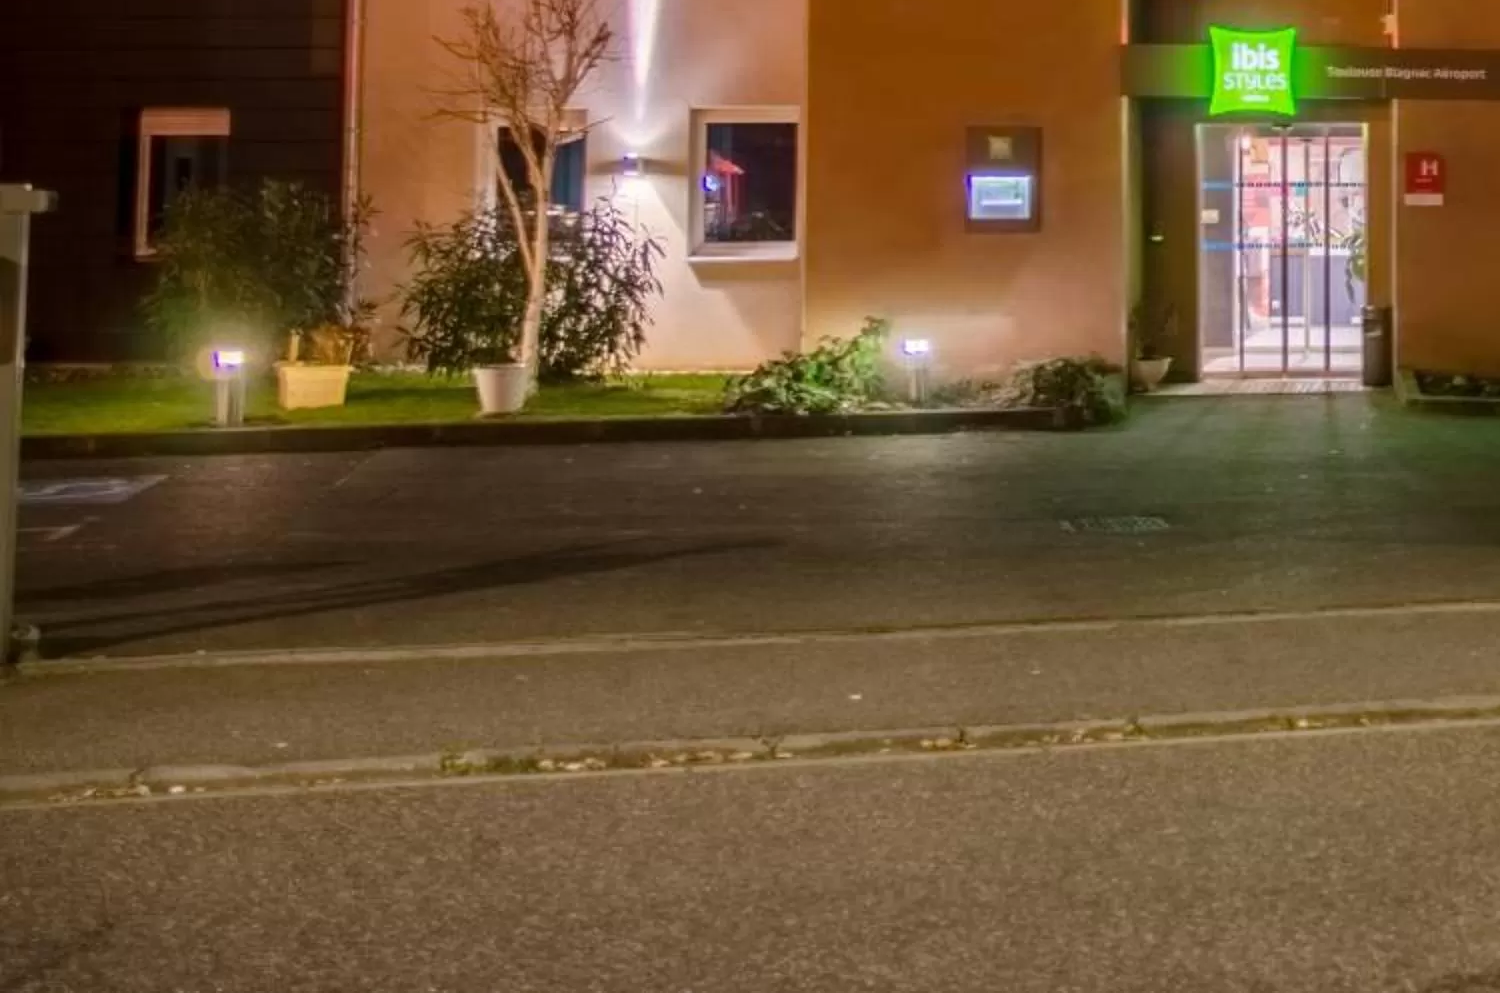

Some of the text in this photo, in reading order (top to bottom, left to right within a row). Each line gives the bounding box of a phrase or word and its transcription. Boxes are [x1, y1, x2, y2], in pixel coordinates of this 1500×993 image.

[1231, 41, 1279, 70] ibis
[1327, 65, 1382, 78] Toulouse
[1384, 66, 1432, 81] Blagnac
